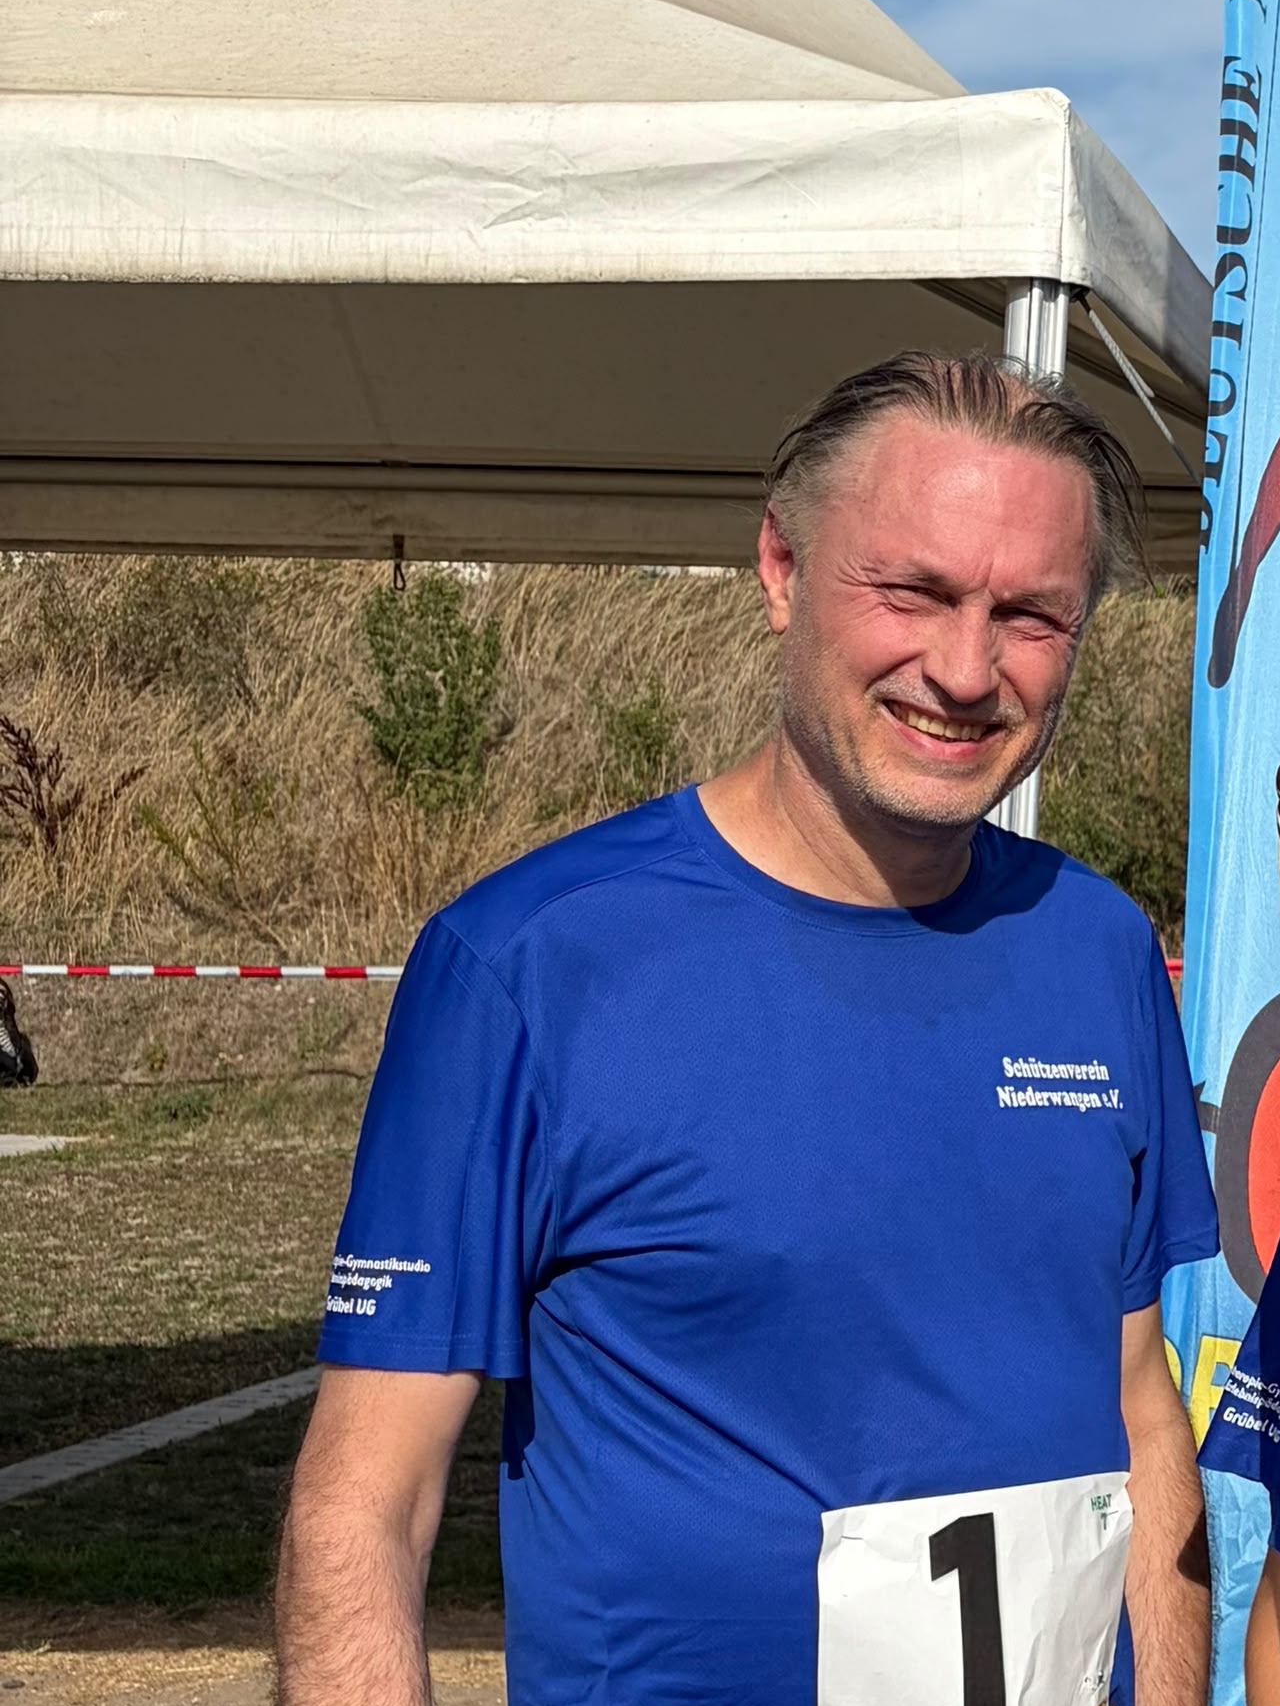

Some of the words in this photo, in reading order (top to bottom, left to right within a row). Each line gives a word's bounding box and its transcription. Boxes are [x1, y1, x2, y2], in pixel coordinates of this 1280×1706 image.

[1002, 1056, 1110, 1080] Schützenverein
[996, 1086, 1101, 1112] Niederwangen
[1102, 1089, 1124, 1109] e.V.
[356, 1298, 377, 1316] UG
[1223, 1407, 1269, 1432] Grübel
[1091, 1493, 1112, 1511] HEAT
